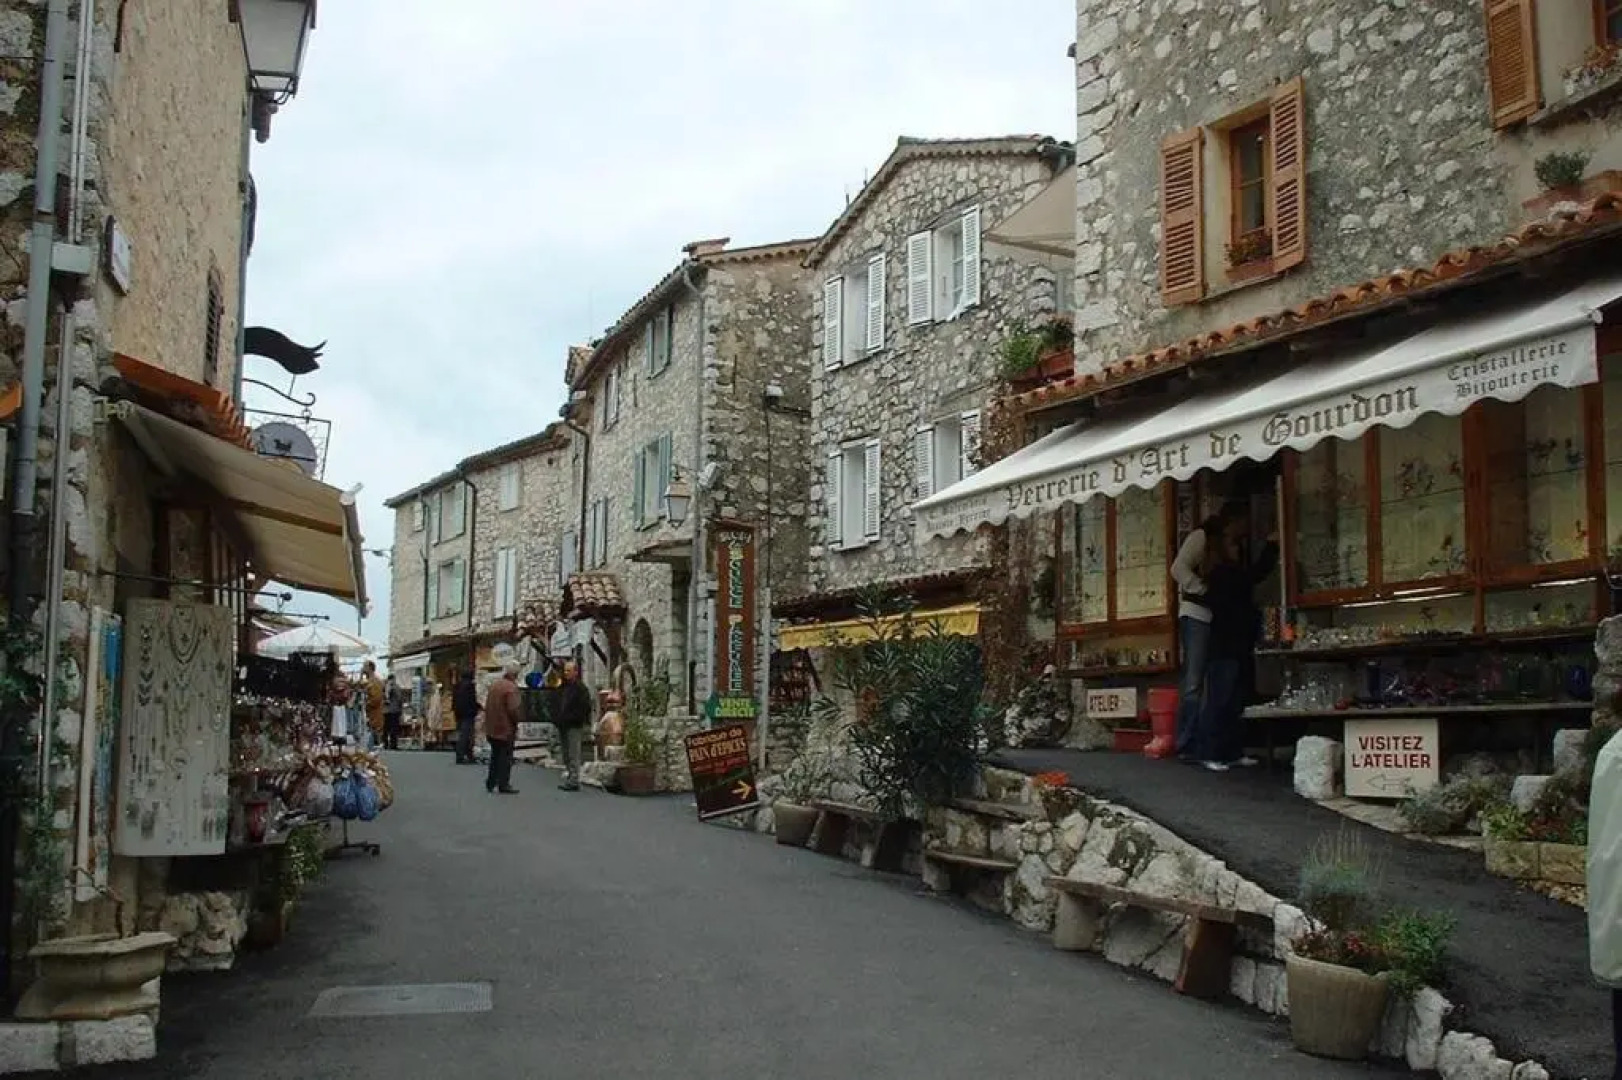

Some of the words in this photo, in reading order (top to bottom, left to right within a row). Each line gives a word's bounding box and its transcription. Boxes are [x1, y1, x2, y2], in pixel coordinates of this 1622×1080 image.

[1448, 341, 1567, 381] Cristallerie
[1456, 363, 1560, 397] Bijouterie
[1006, 470, 1100, 510] Verrerie
[1112, 447, 1190, 483] d'Art
[1209, 431, 1241, 459] de
[1262, 386, 1419, 446] Gourdon
[1089, 694, 1119, 712] ATELIER
[1358, 736, 1423, 751] VISITEZ
[1352, 753, 1431, 768] L'ATELIER
